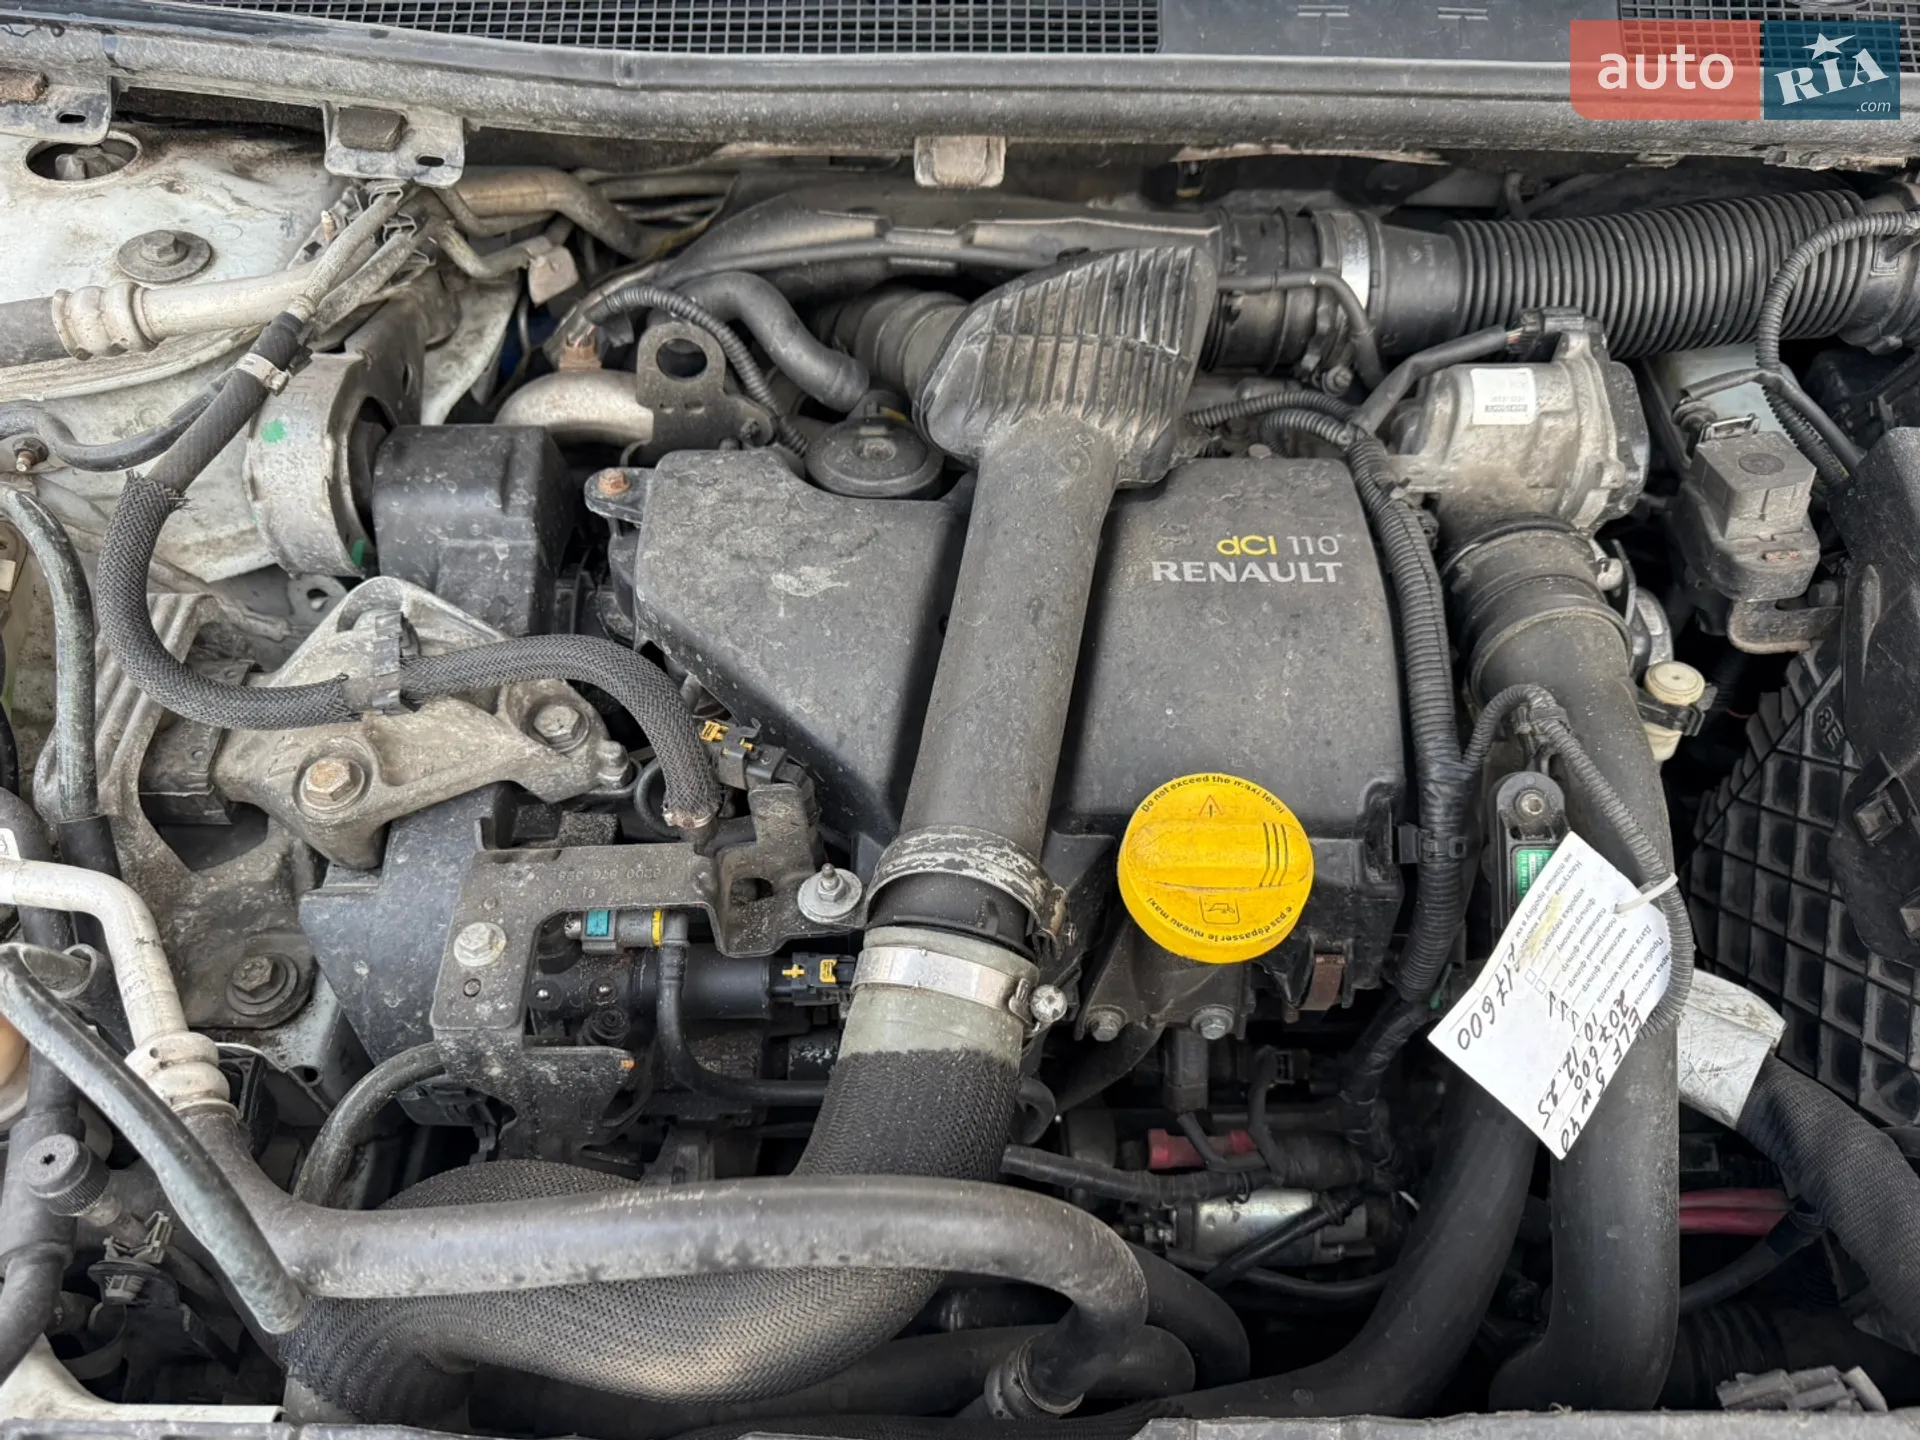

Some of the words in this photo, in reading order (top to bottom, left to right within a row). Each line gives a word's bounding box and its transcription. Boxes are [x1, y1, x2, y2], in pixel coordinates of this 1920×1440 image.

[1287, 535, 1339, 556] 110
[1151, 561, 1342, 583] RENAULT
[1141, 800, 1154, 812] Do
[1154, 787, 1170, 801] not
[1170, 775, 1210, 790] exceed
[1212, 775, 1230, 784] the
[1564, 853, 1571, 862] не
[1554, 860, 1581, 894] Наступна
[1146, 897, 1169, 919] maxi
[1562, 888, 1583, 918] коробка
[1575, 898, 1594, 924] фільтр
[1170, 918, 1204, 937] niveau
[1208, 933, 1218, 942] le
[1542, 918, 1562, 949] передач
[1556, 925, 1575, 952] салону
[1579, 908, 1606, 944] паливний
[1586, 917, 1616, 959] повітряний
[1635, 924, 1651, 944] Дата
[1561, 945, 1579, 971] фільтр
[1600, 927, 1626, 964] масляний
[1618, 944, 1636, 969] заміни
[1644, 937, 1663, 962] Пробіг
[1568, 960, 1586, 987] фільтр
[1582, 965, 1600, 991] фільтр
[1596, 971, 1618, 1002] мастила
[1634, 973, 1656, 1004] мастила
[1612, 1006, 1641, 1064] ELF
